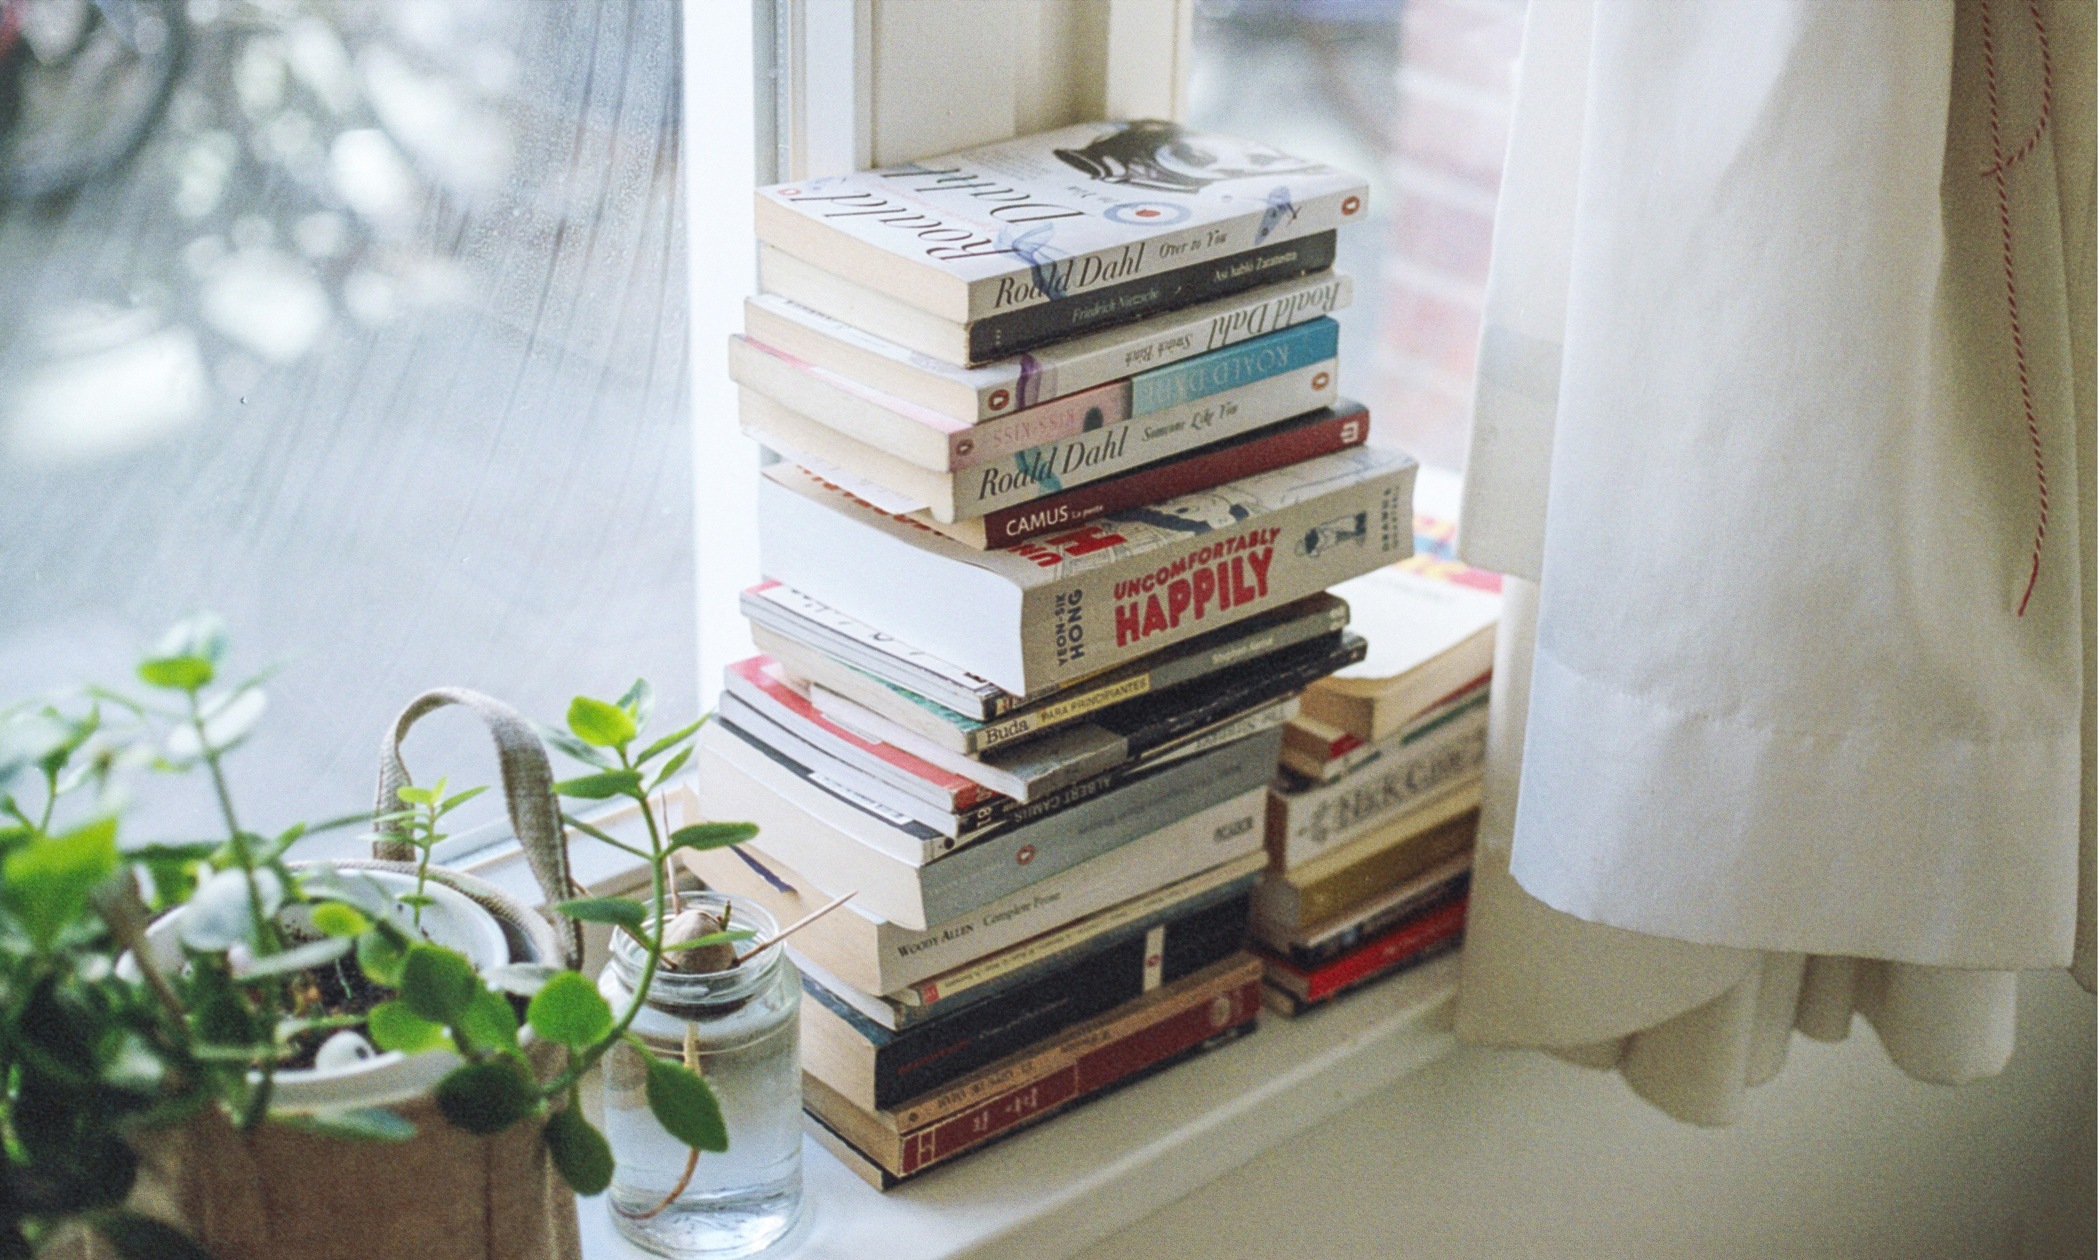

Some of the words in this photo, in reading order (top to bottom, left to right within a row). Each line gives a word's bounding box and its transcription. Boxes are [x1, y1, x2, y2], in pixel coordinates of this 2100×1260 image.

[880, 167, 1086, 224] Dahl
[789, 192, 1018, 260] Roald
[995, 256, 1074, 308] Roald
[1078, 241, 1146, 288] Dahl
[1159, 242, 1189, 258] Over
[1190, 239, 1201, 250] to
[1207, 229, 1228, 247] You
[1072, 302, 1116, 323] Friedrich
[1207, 303, 1269, 350] Dahl
[1274, 282, 1341, 331] Roald
[1125, 345, 1154, 367] Bitch
[1158, 332, 1194, 354] Switch
[1208, 345, 1290, 384] ROALD
[1143, 368, 1205, 405] DAHL
[979, 449, 1055, 500] Roald
[1061, 425, 1130, 475] Dahl
[1142, 416, 1186, 443] Someone
[1217, 401, 1239, 420] You
[1005, 505, 1069, 536] CAMUS
[1071, 510, 1081, 519] La
[1114, 527, 1281, 600] UNCOMFORTABLY
[1067, 588, 1084, 661] HONG
[1115, 546, 1274, 647] HAPPILY
[1055, 590, 1066, 668] YEON-SIK
[985, 719, 1029, 745] Buda
[1041, 706, 1069, 722] PARA
[1070, 679, 1148, 714] PRINCIPIANTES
[1065, 776, 1113, 802] ALBERT
[898, 935, 941, 957] WOODY
[941, 924, 975, 943] ALLEN
[983, 901, 1030, 927] Complete
